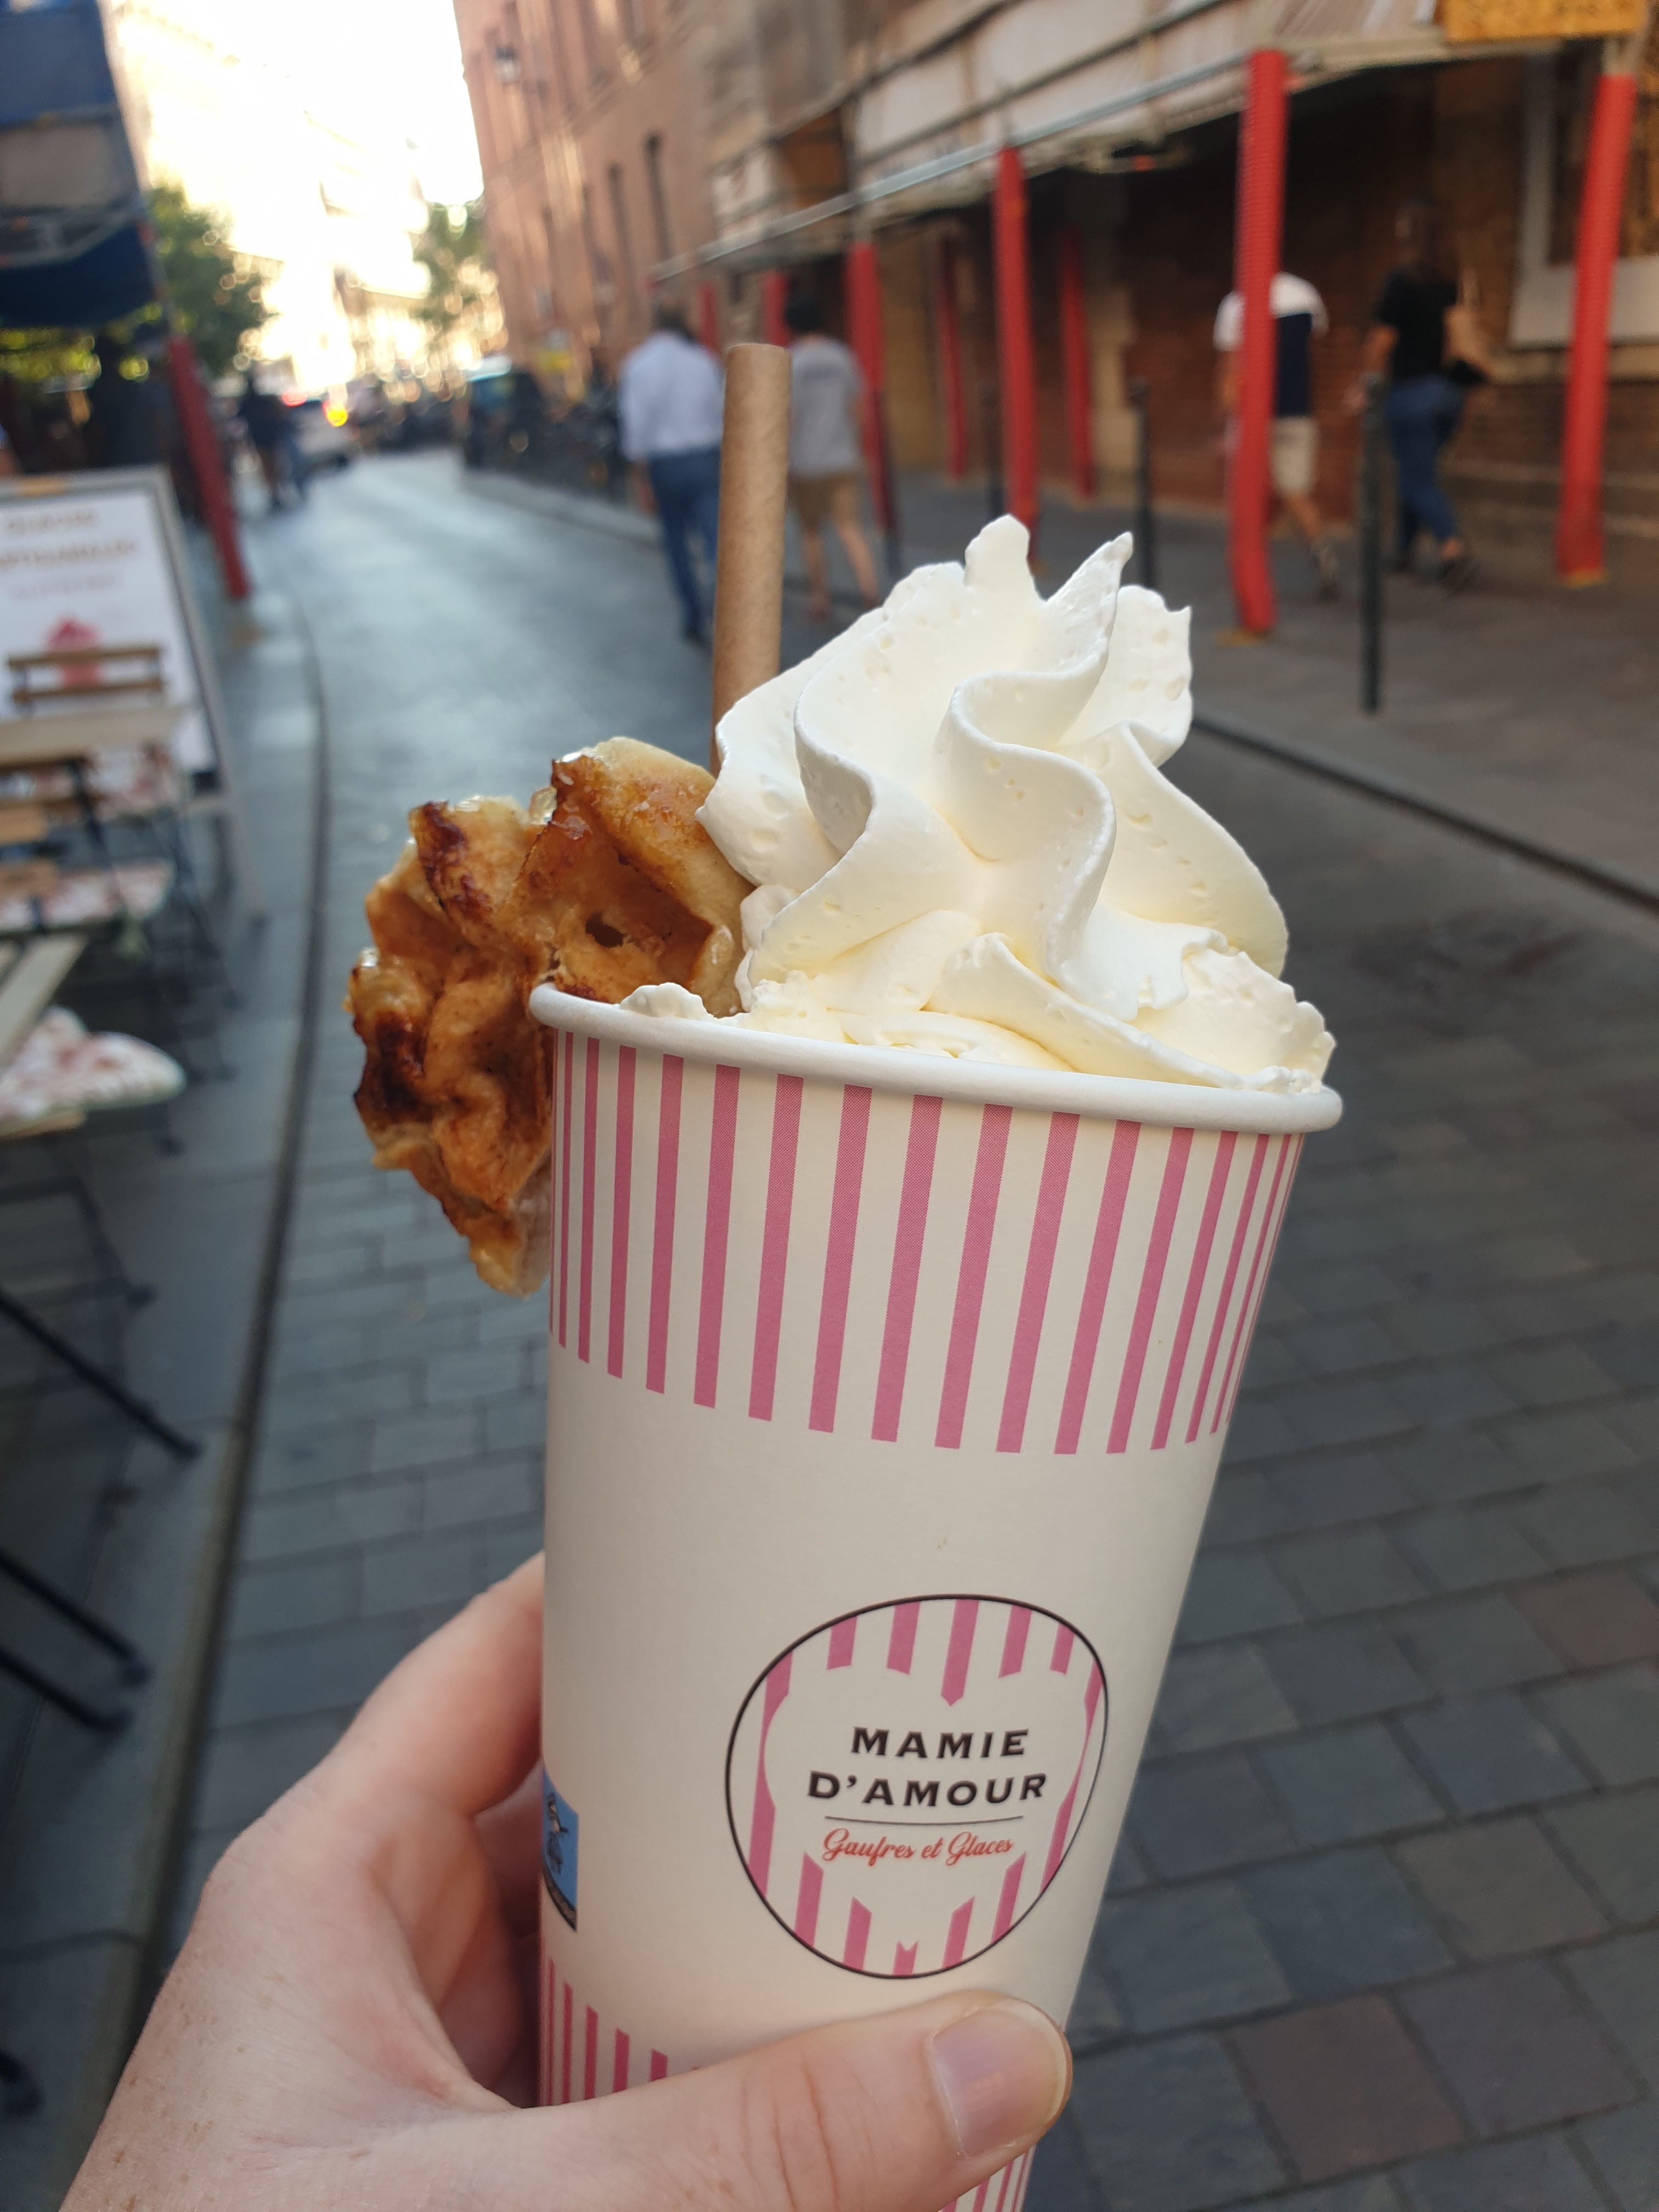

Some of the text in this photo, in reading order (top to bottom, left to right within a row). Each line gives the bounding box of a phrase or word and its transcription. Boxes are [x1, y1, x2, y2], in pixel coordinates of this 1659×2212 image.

[851, 1726, 1029, 1759] MAMIE
[808, 1770, 1046, 1807] D’AMOUR
[821, 1827, 1014, 1867] Gaufres et Glaces
